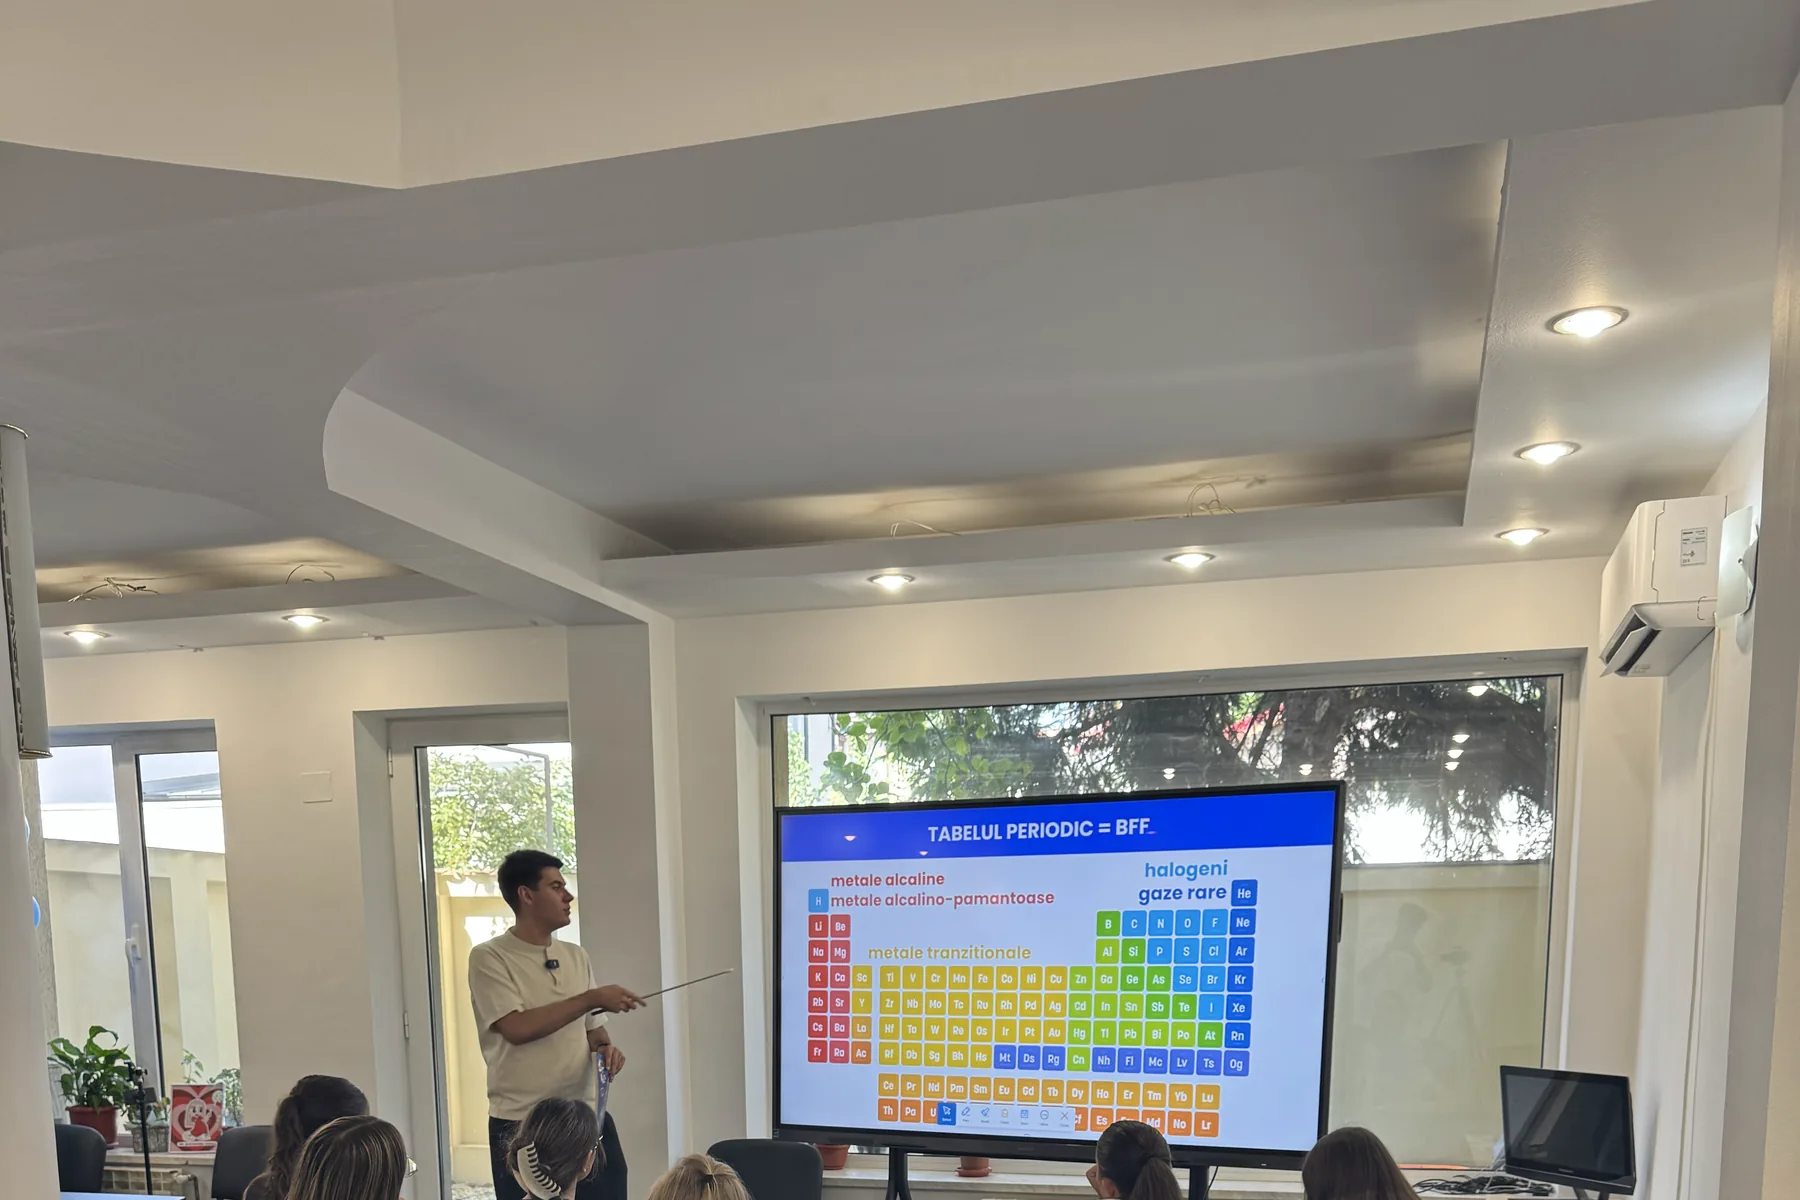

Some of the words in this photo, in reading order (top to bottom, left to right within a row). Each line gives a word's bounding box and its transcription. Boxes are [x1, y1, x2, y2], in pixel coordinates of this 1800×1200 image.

[928, 824, 1002, 842] TABELUL
[1006, 820, 1093, 840] PERIODIC
[1098, 822, 1111, 834] =
[1116, 818, 1150, 835] BFF
[831, 873, 882, 887] metale
[885, 871, 945, 886] alcaline
[1145, 859, 1228, 881] halogeni
[831, 893, 881, 907] metale
[885, 891, 1055, 909] alcalino-pamantoase
[1139, 885, 1183, 905] gaze
[1187, 884, 1227, 900] rare
[1237, 888, 1251, 898] He
[815, 921, 822, 931] Li
[835, 922, 846, 931] Be
[1105, 919, 1112, 929] B
[1131, 919, 1138, 929] C
[1157, 919, 1164, 928] N
[1184, 918, 1191, 928] O
[1212, 918, 1218, 928] F
[1236, 917, 1250, 927] Ne
[813, 947, 824, 956] Na
[834, 947, 846, 959] Mg
[1102, 946, 1112, 956] Al
[1128, 946, 1138, 957] Si
[1156, 947, 1163, 956] P
[1183, 946, 1190, 956] S
[1209, 946, 1219, 956] Cl
[1235, 946, 1247, 956] Ar
[868, 946, 923, 960] metale
[927, 944, 1031, 960] tranzitionale
[815, 972, 821, 982] K
[835, 973, 845, 982] Ca
[857, 973, 867, 982] Sc
[910, 973, 916, 983] V
[931, 973, 941, 983] Cr
[952, 974, 966, 983] Mn
[978, 973, 988, 983] Fe
[1001, 974, 1013, 984] Co
[1050, 974, 1062, 984] Cu
[1075, 974, 1087, 984] Zn
[1100, 974, 1113, 984] Ga
[1126, 974, 1139, 984] Ge
[1152, 974, 1165, 984] As
[1179, 975, 1192, 984] Se
[1207, 975, 1218, 984] Br
[1234, 975, 1246, 984] Kr
[813, 997, 823, 1007] Rb
[835, 998, 844, 1007] Sr
[859, 998, 865, 1007] Y
[929, 1000, 942, 1009] Mo
[954, 1000, 964, 1009] Tc
[976, 1000, 988, 1010] Ru
[1000, 1000, 1012, 1010] Rh
[1024, 1000, 1037, 1010] Pd
[1049, 1001, 1061, 1013] Ag
[1074, 1001, 1087, 1011] Cd
[1101, 1001, 1111, 1011] In
[1125, 1001, 1138, 1012] Sn
[1151, 1001, 1164, 1012] Sb
[1178, 1002, 1190, 1012] Te
[1232, 1003, 1245, 1013] Xe
[813, 1022, 823, 1032] Cs
[834, 1023, 845, 1032] Ba
[857, 1024, 867, 1033] La
[930, 1025, 939, 1034] W
[1002, 1027, 1009, 1036] Ir
[1025, 1027, 1035, 1036] Pt
[1048, 1028, 1061, 1037] Au
[1073, 1028, 1086, 1040] Hg
[1124, 1029, 1137, 1039] Pb
[1152, 1029, 1162, 1040] Bi
[1177, 1029, 1190, 1040] Po
[1204, 1030, 1216, 1040] At
[1231, 1031, 1244, 1041] Rn
[814, 1047, 822, 1056] Fr
[834, 1048, 845, 1057] Ra
[856, 1048, 867, 1058] Ac
[929, 1051, 940, 1063] Sg
[975, 1052, 987, 1062] Hs
[999, 1053, 1010, 1062] Mt
[1023, 1053, 1035, 1063] Ds
[1048, 1054, 1059, 1066] Rg
[1072, 1054, 1085, 1064] Cn
[1098, 1055, 1110, 1065] Nh
[1125, 1056, 1134, 1066] Fl
[1149, 1057, 1163, 1067] Mc
[1177, 1058, 1188, 1067] Lv
[1203, 1058, 1214, 1068] Ts
[1230, 1059, 1243, 1071] Og
[906, 1081, 916, 1091] Pr
[950, 1083, 964, 1093] Pm
[973, 1084, 987, 1094] Sm
[998, 1085, 1010, 1095] Eu
[1022, 1086, 1034, 1096] Gd
[1047, 1087, 1058, 1097] Tb
[1096, 1089, 1109, 1099] Ho
[1123, 1090, 1134, 1100] Er
[1147, 1090, 1162, 1100] Tm
[1175, 1091, 1187, 1102] Yb
[883, 1105, 893, 1115] Th
[905, 1107, 916, 1116] Pa
[1096, 1115, 1108, 1125] Es
[1173, 1119, 1186, 1129] No
[1201, 1120, 1211, 1130] Lr
